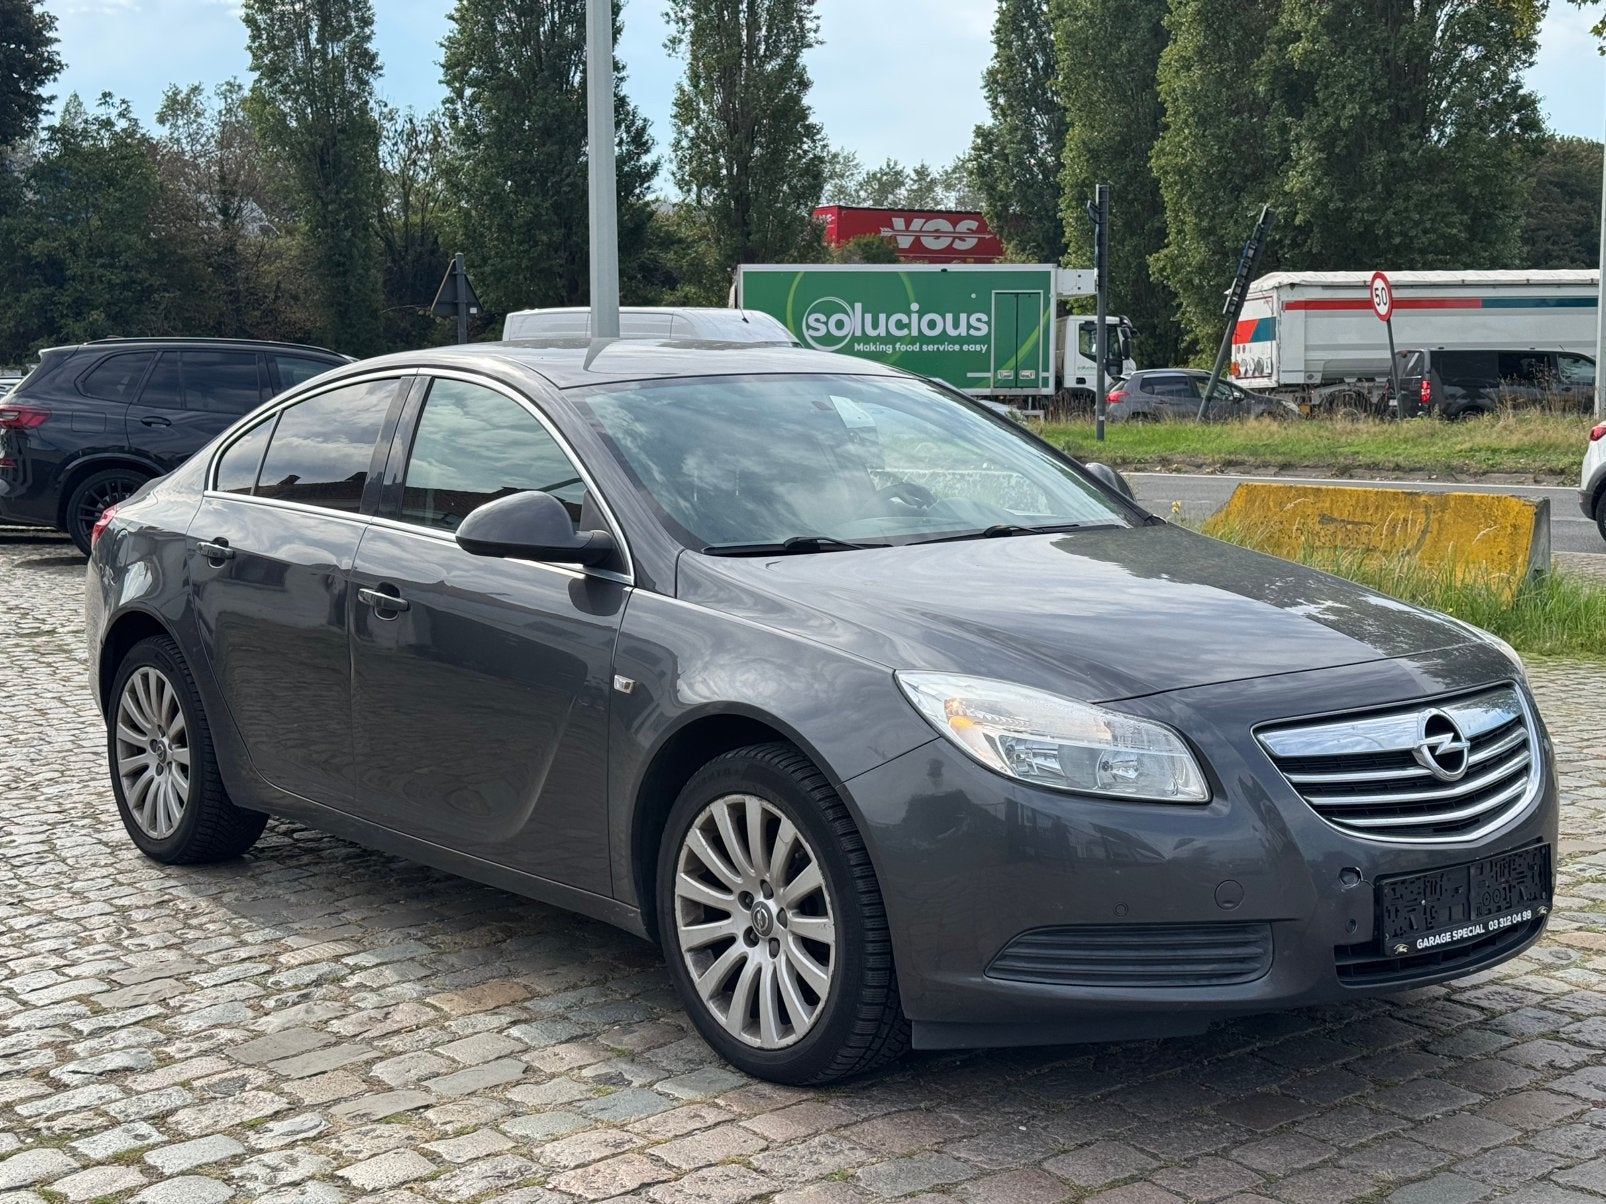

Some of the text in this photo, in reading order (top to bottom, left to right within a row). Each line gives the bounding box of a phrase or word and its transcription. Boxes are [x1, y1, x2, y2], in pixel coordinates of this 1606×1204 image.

[1374, 287, 1387, 306] 50
[807, 302, 989, 337] solucious
[854, 342, 988, 353] Making food service easy
[1416, 909, 1532, 949] GARAGE SPECIAL 03 312 04 99
